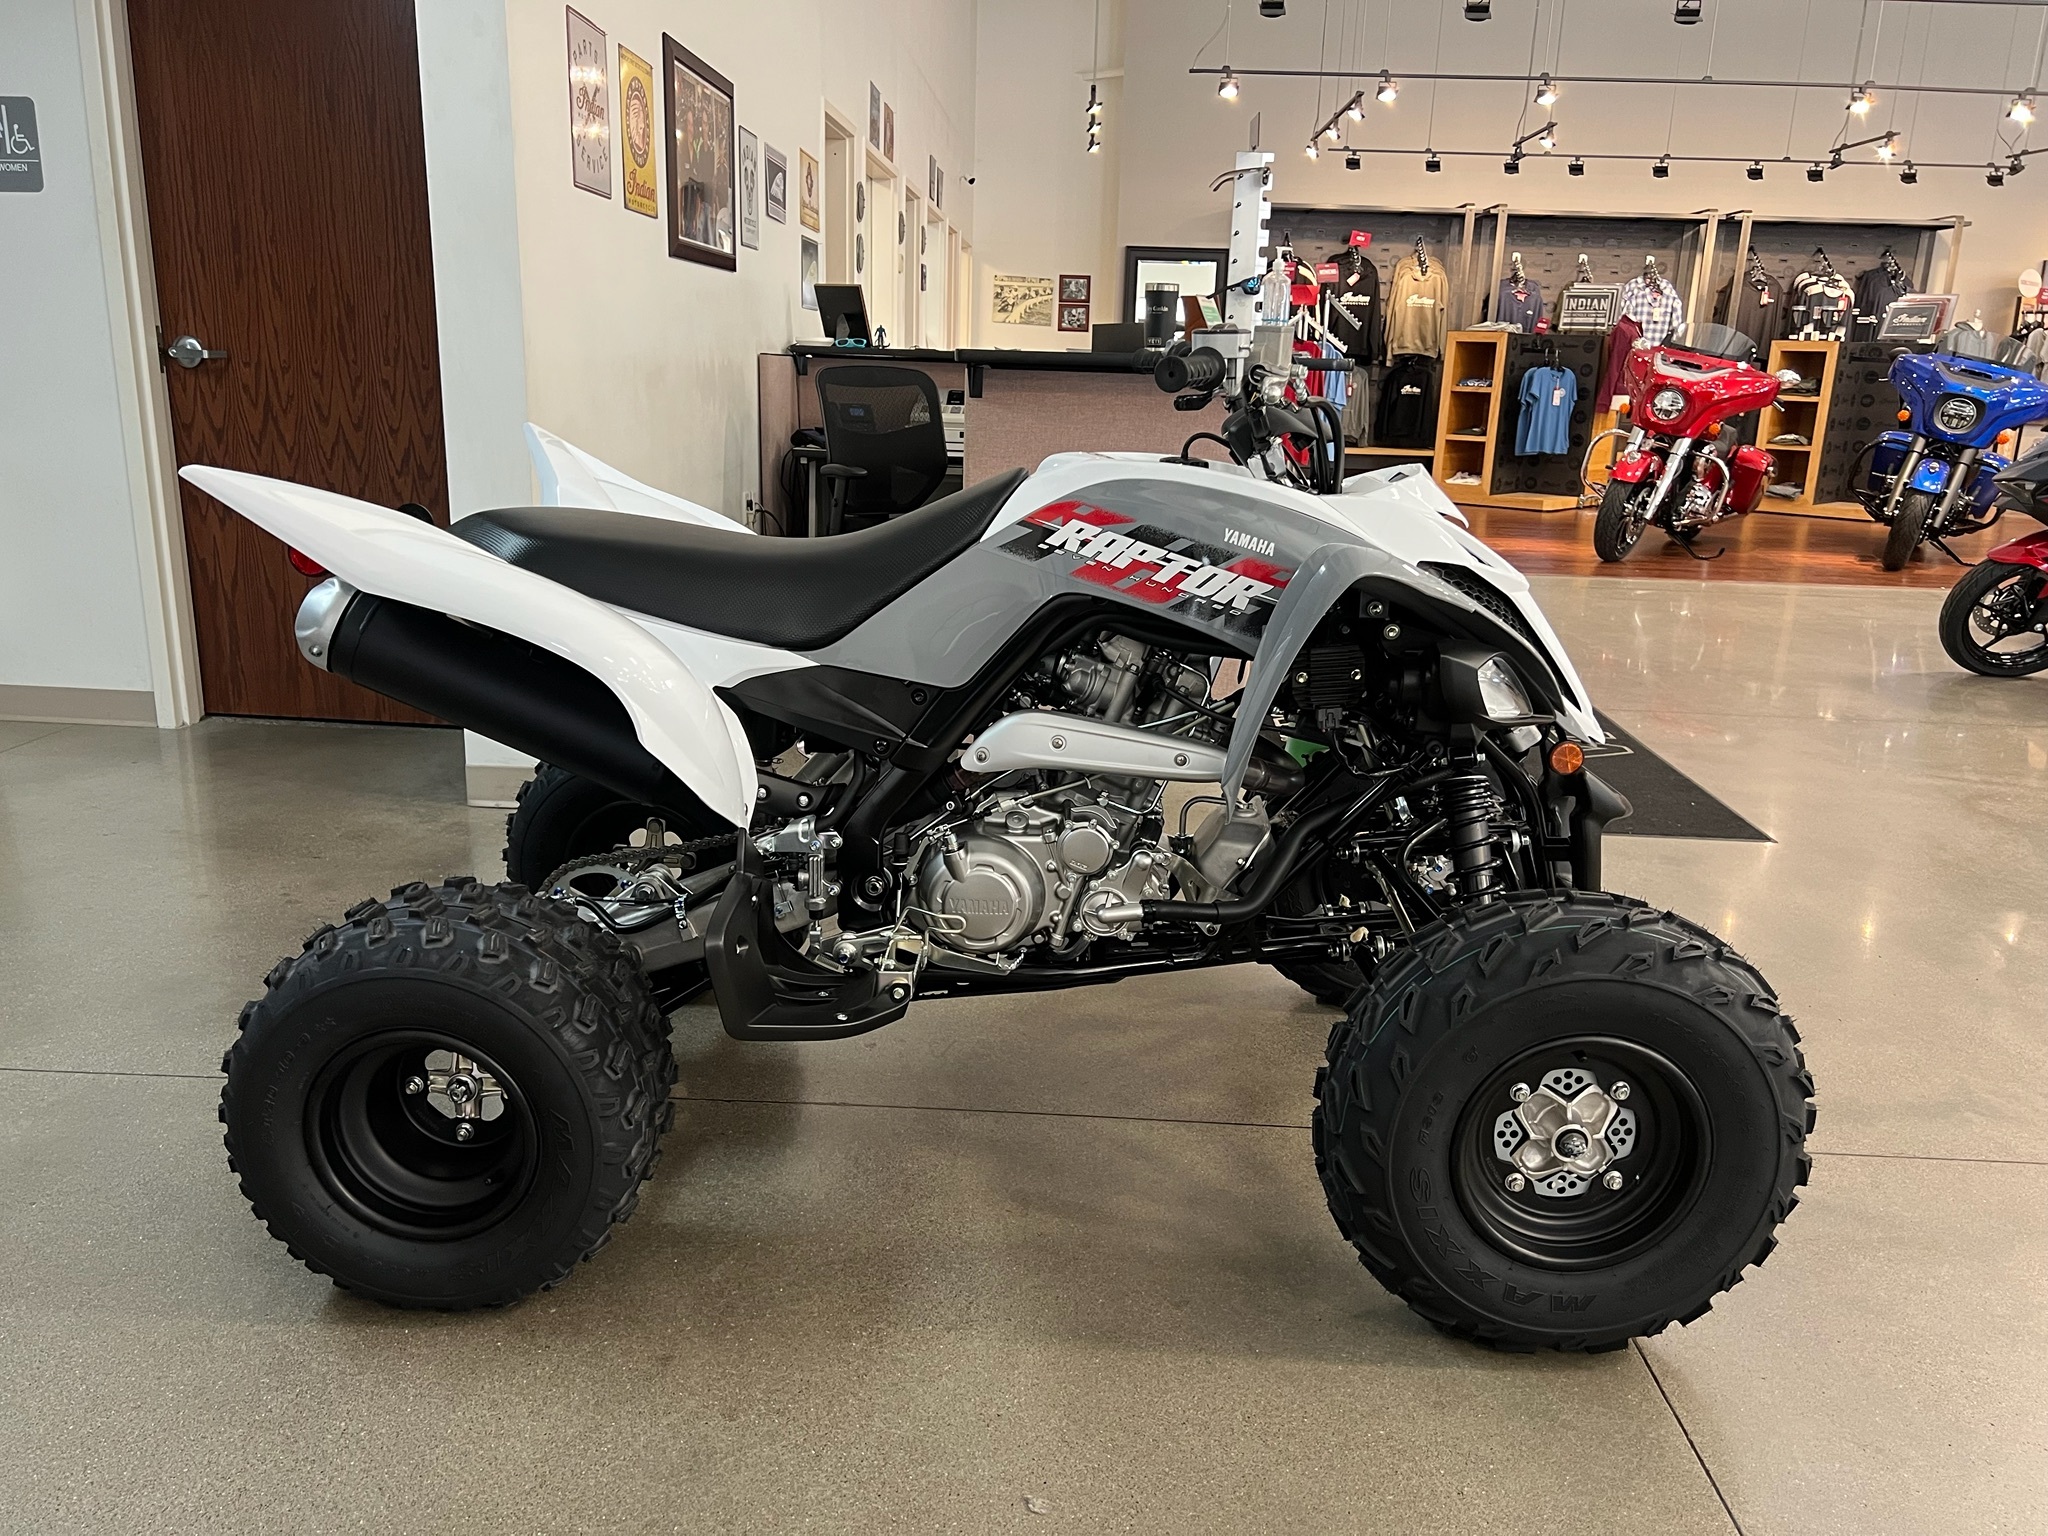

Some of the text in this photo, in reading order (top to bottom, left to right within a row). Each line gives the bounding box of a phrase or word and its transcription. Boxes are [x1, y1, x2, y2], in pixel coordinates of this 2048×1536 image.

[626, 168, 656, 202] Indian
[1564, 298, 1609, 310] INDIAN
[1224, 527, 1275, 557] YAMAHA
[1044, 518, 1275, 611] RAPTOR
[950, 899, 1009, 915] YAMAHA
[1410, 1167, 1598, 1313] MAXXIS
